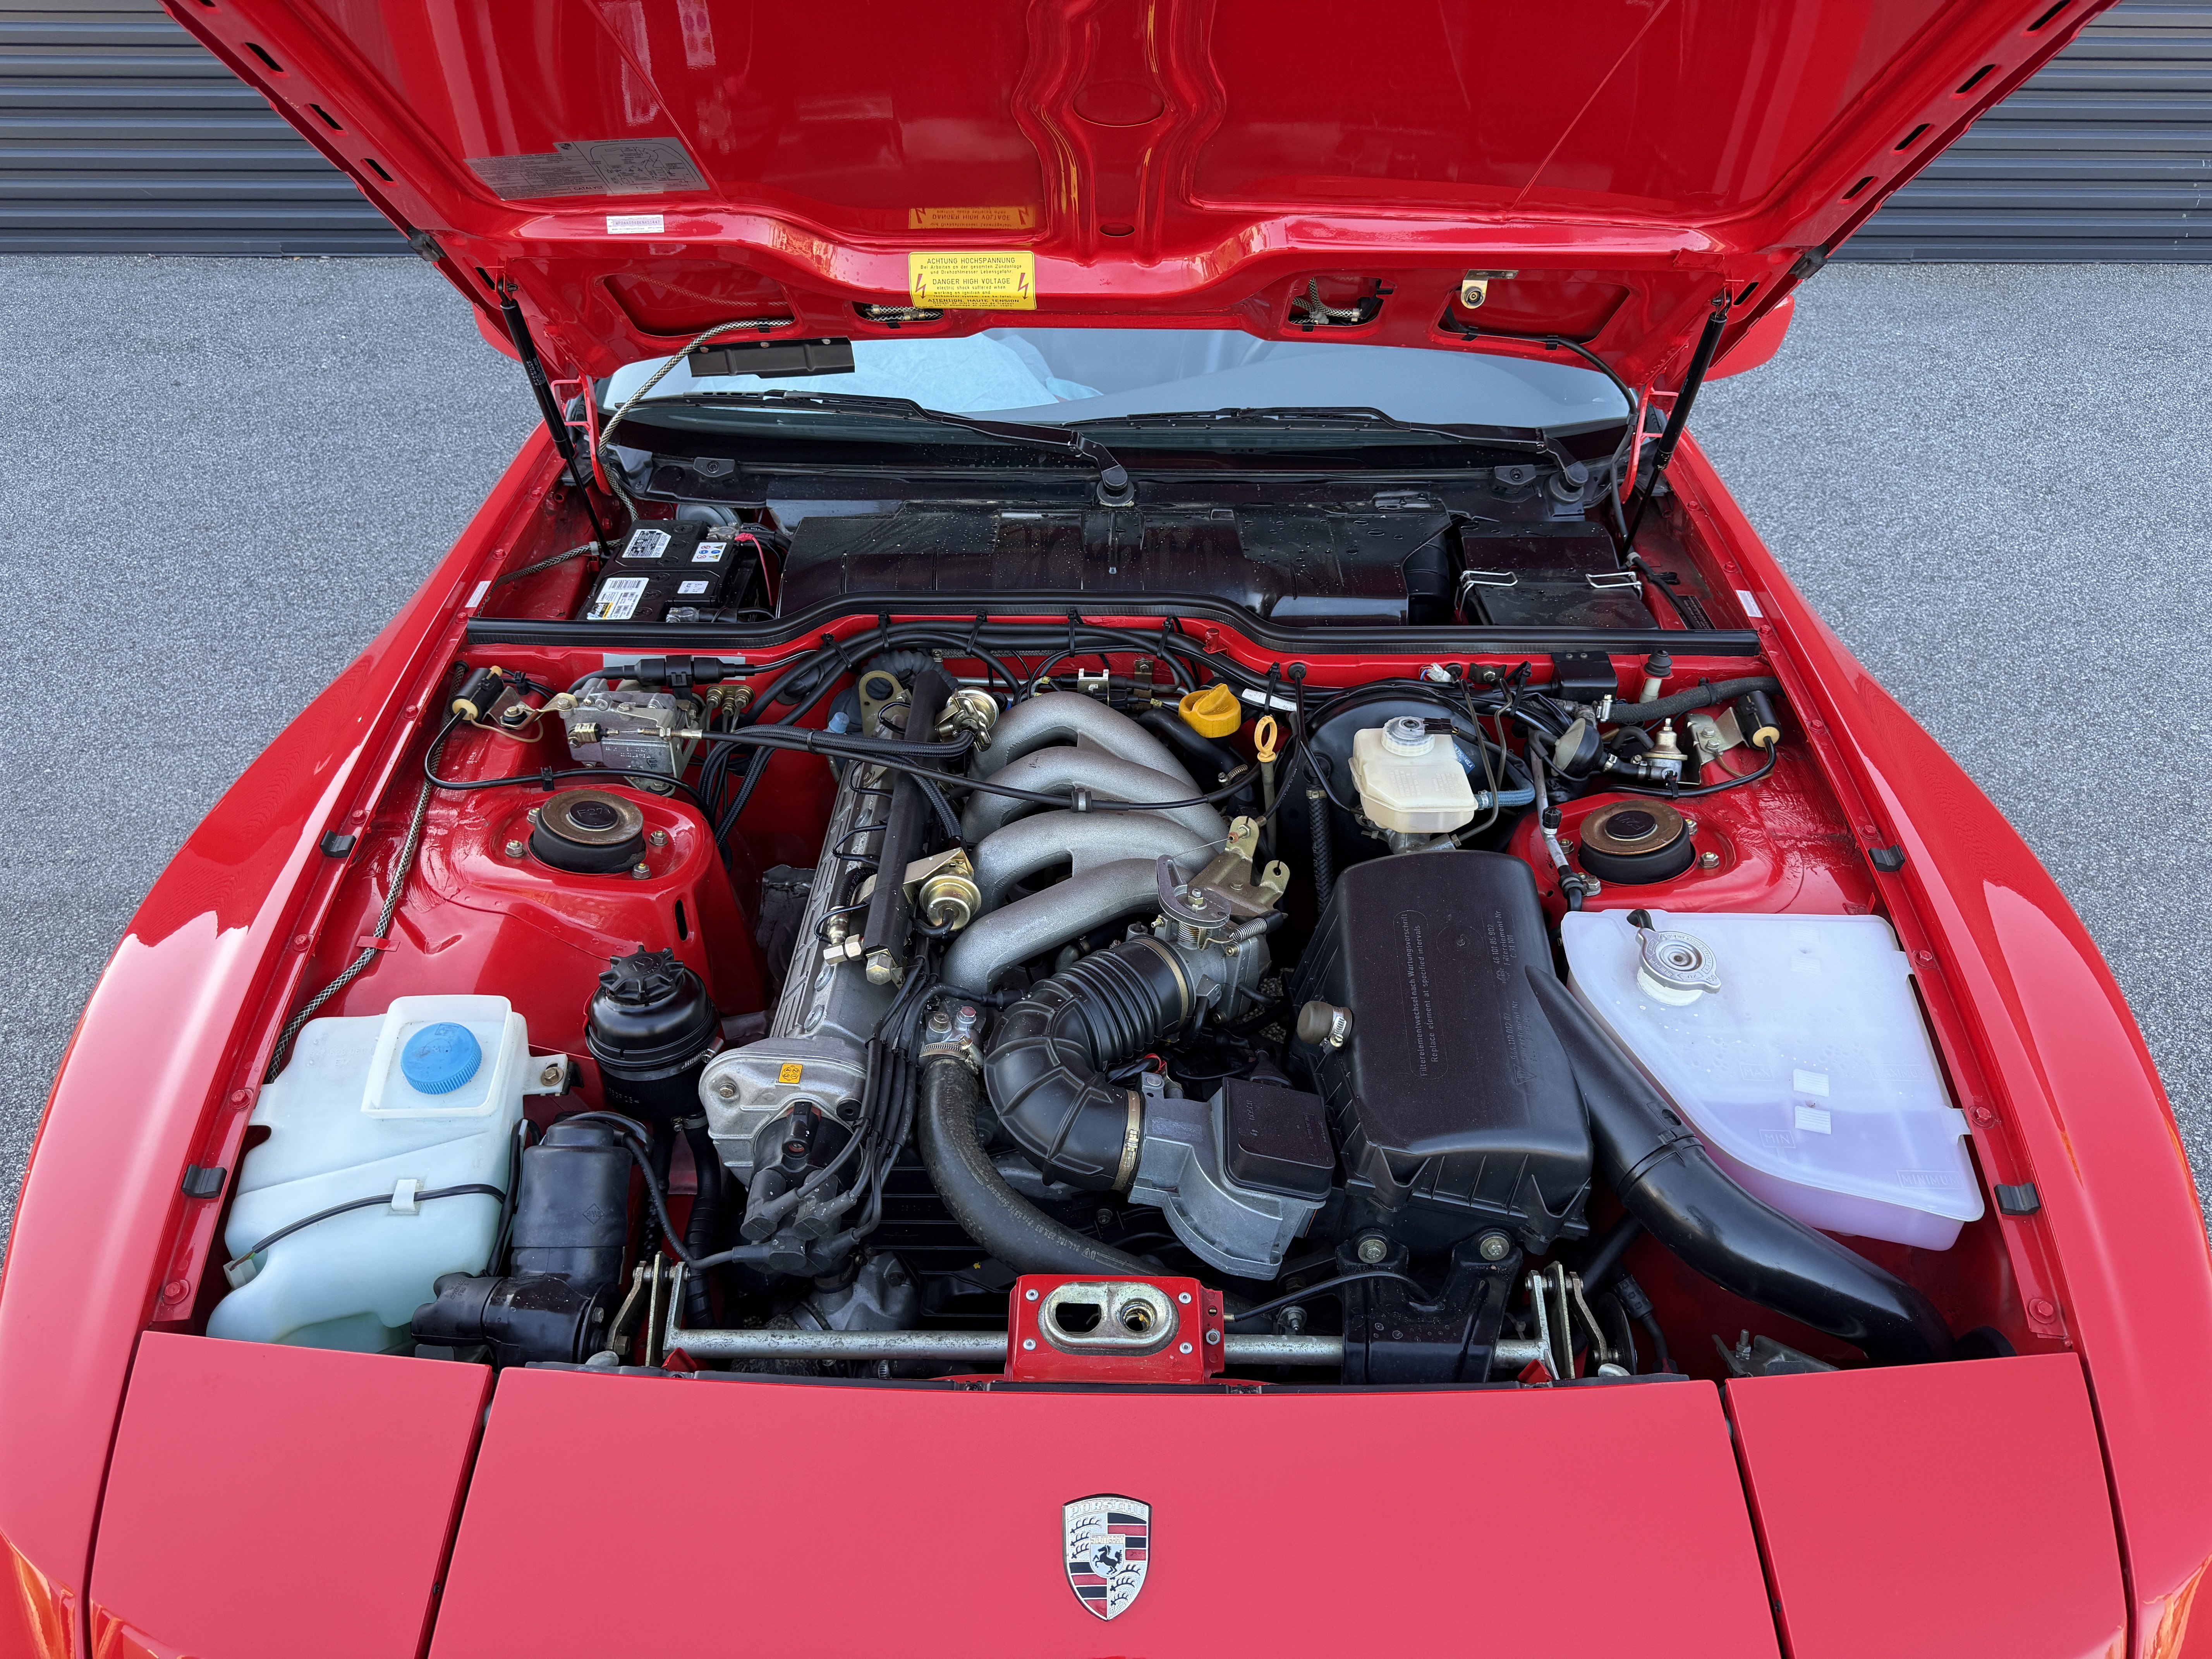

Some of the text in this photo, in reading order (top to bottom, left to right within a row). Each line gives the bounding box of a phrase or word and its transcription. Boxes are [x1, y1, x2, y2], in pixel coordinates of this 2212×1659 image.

[1414, 925, 1424, 954] intervals
[1418, 957, 1429, 987] specified
[1401, 914, 1428, 1077] Filterelementwechsel nach Wartungsvorschrift
[1424, 1001, 1434, 1029] element
[1429, 1032, 1439, 1062] Replace
[1744, 1068, 1771, 1078] MAX
[1765, 1134, 1790, 1144] MIN
[1901, 1173, 1961, 1185] MINIMUM
[1069, 1500, 1146, 1517] PORSCHE
